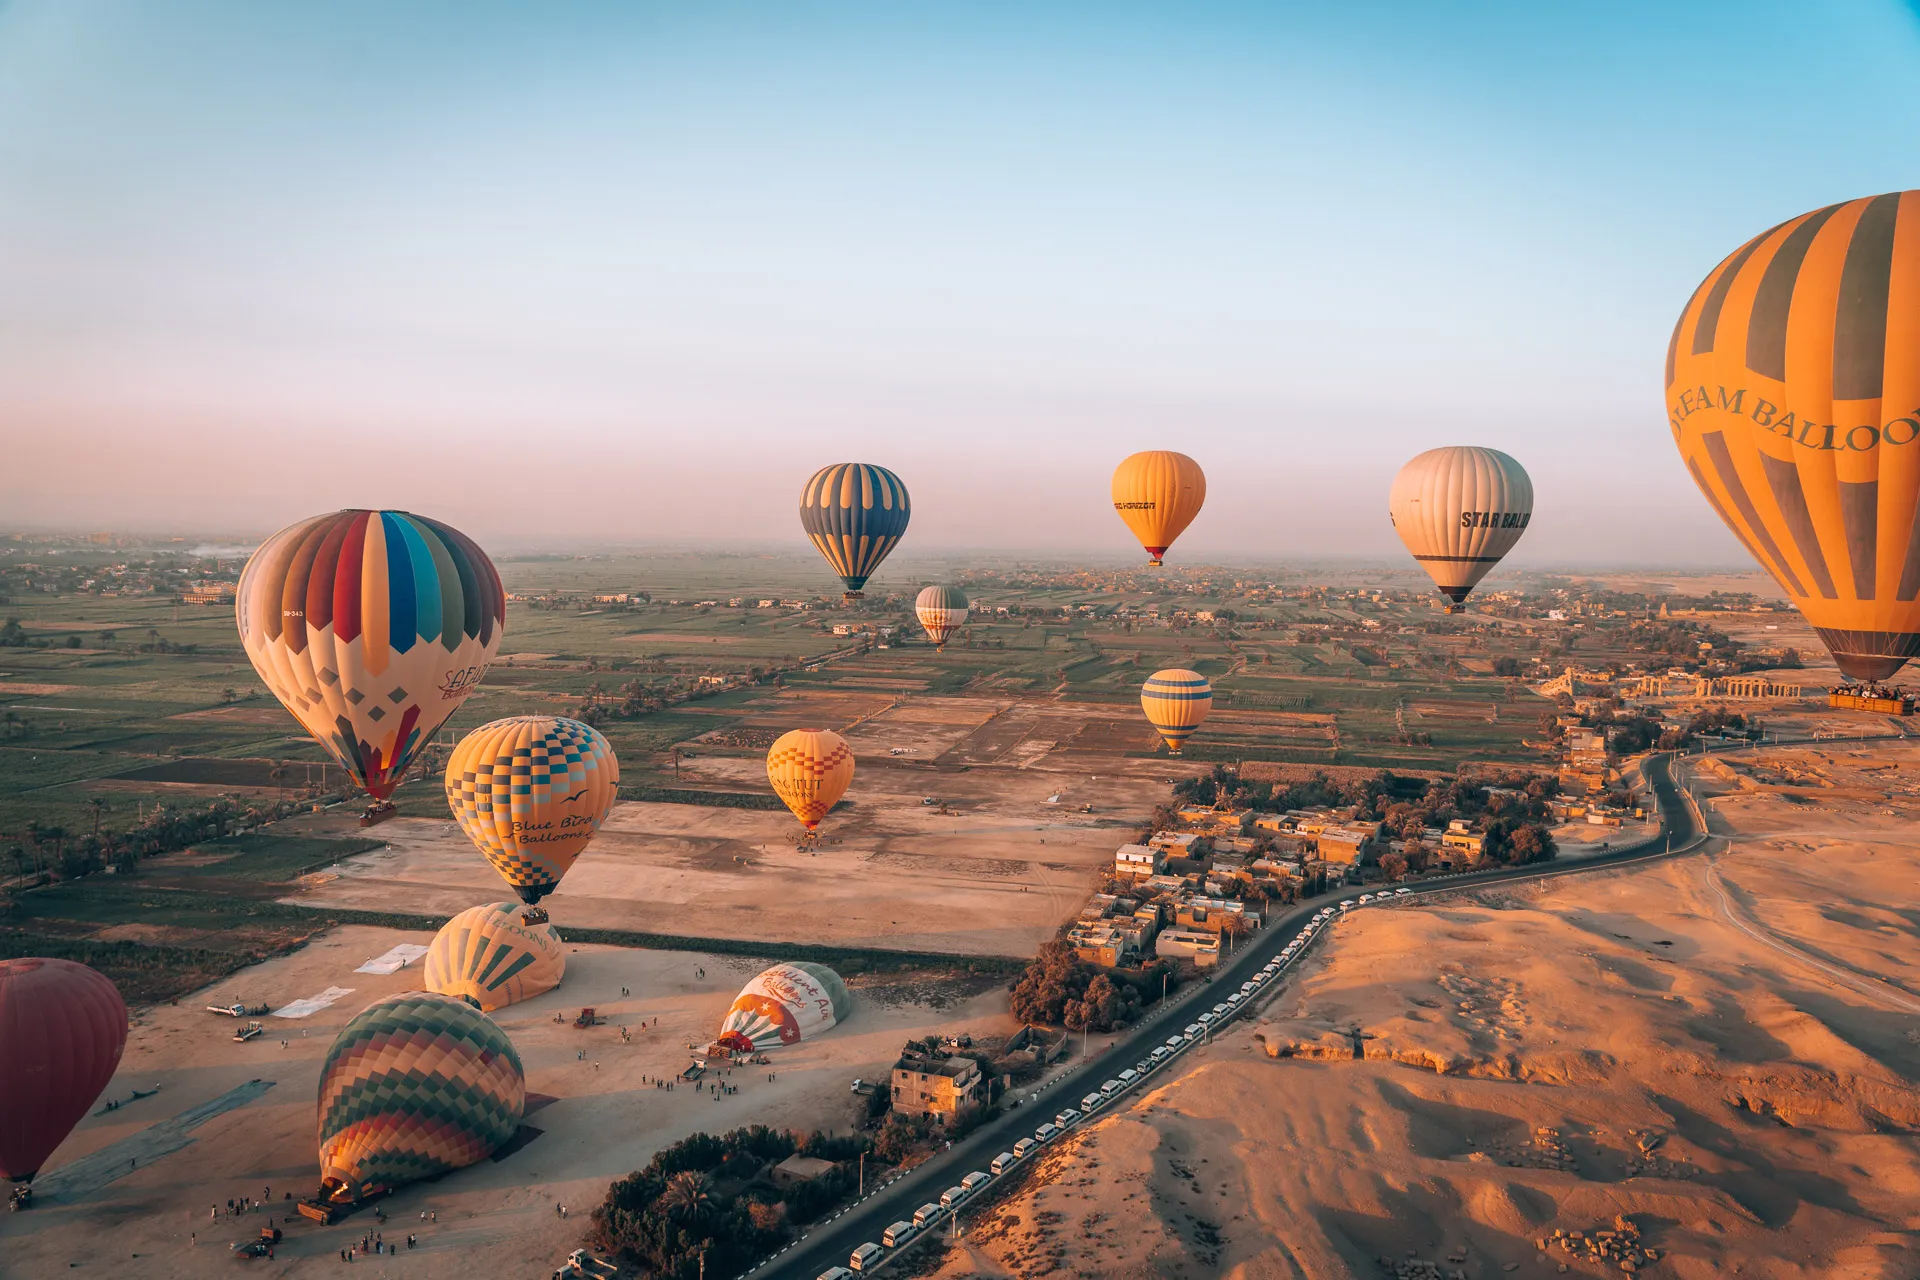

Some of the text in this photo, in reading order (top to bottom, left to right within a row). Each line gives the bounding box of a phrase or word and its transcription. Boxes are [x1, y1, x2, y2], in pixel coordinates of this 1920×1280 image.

[1750, 397, 1920, 452] BALLOO
[1461, 511, 1500, 528] STAR
[793, 778, 824, 791] TUT
[511, 813, 594, 832] Blue Bird
[519, 831, 584, 845] Balloons
[759, 970, 829, 1021] xcellent Air
[762, 977, 807, 1009] Balloons
